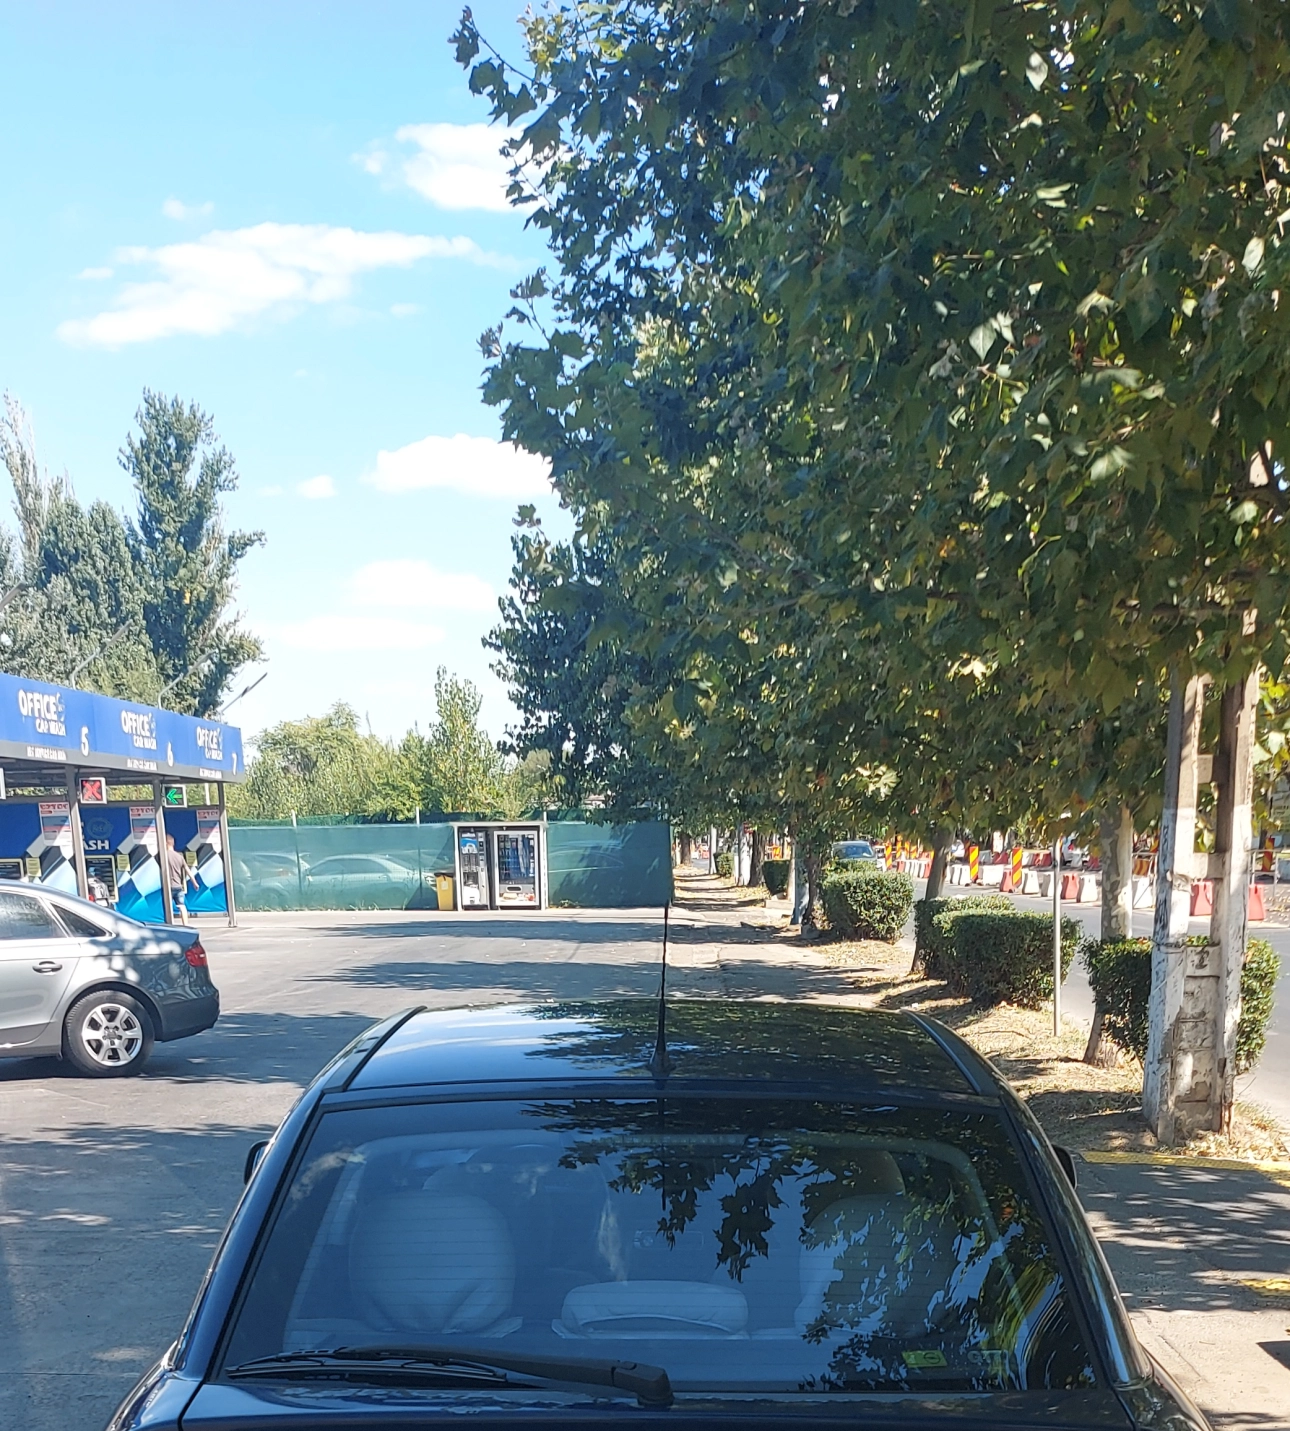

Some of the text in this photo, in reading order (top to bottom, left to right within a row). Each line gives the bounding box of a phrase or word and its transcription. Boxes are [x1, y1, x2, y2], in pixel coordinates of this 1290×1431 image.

[18, 689, 58, 721] OFFICE
[121, 710, 151, 737] OFFICE
[81, 726, 89, 756] 5
[196, 726, 218, 750] OFFICE
[167, 741, 174, 767] 6
[232, 752, 238, 776] 7
[82, 839, 110, 851] ASH
